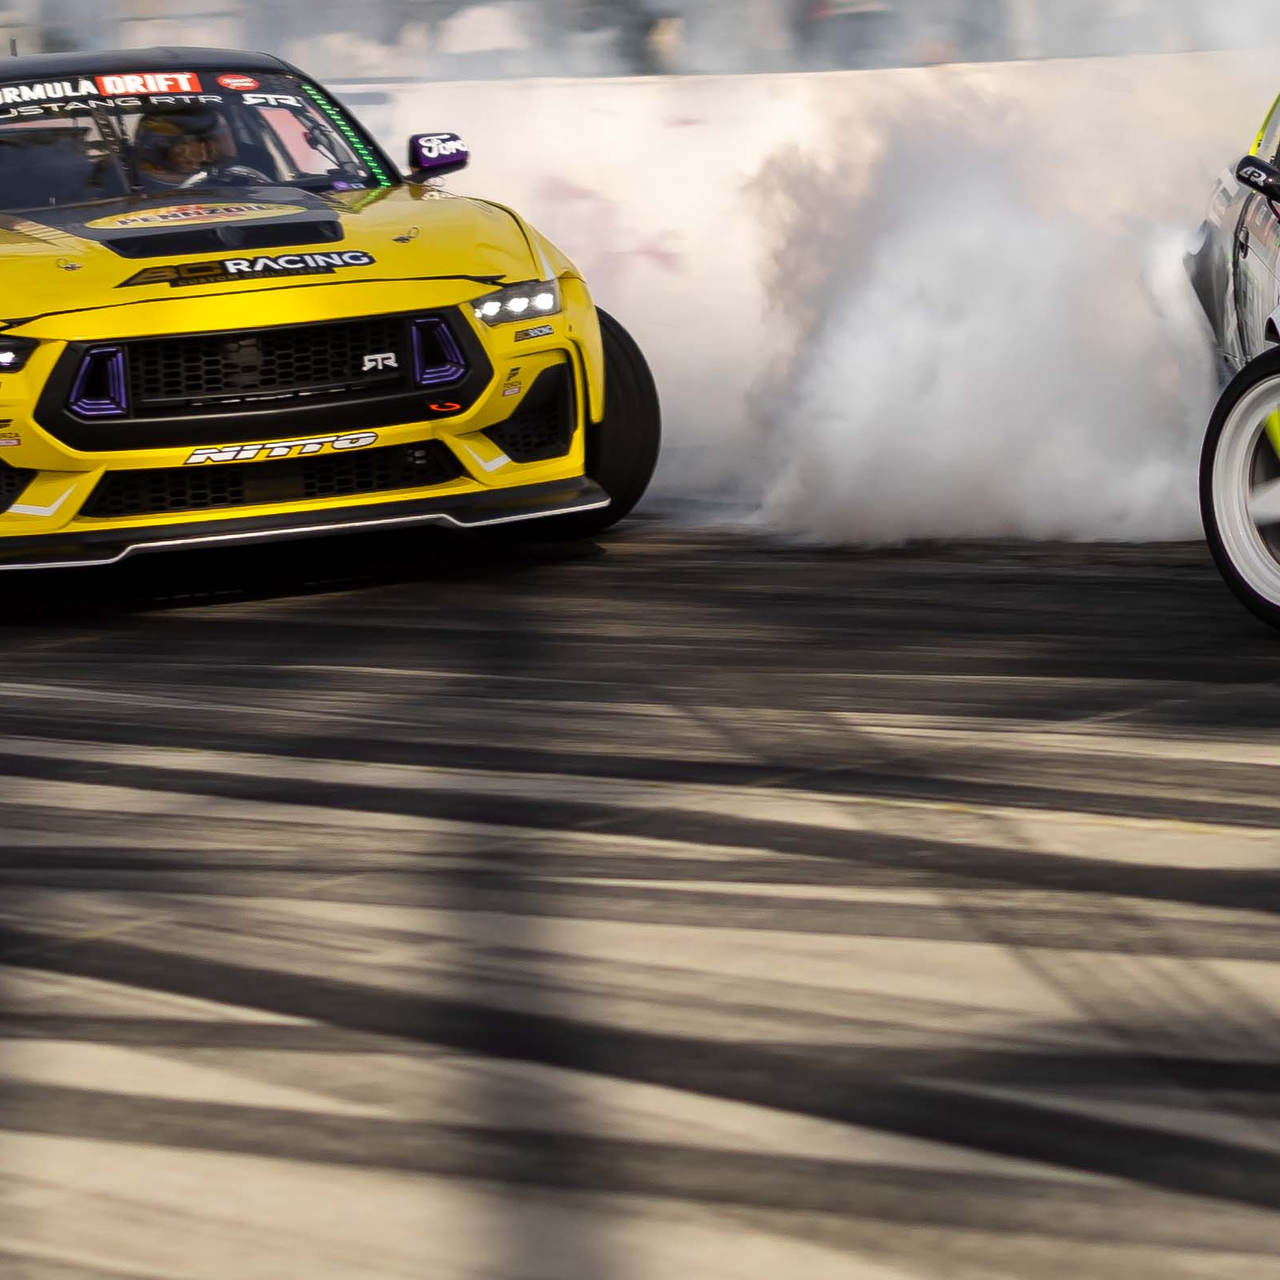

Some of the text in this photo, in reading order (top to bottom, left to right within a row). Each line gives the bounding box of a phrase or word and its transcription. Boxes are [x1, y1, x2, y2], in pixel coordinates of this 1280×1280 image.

[101, 73, 193, 95] DRIFT
[150, 95, 223, 106] RTR
[224, 251, 371, 274] RACING
[184, 432, 377, 465] NITTO
